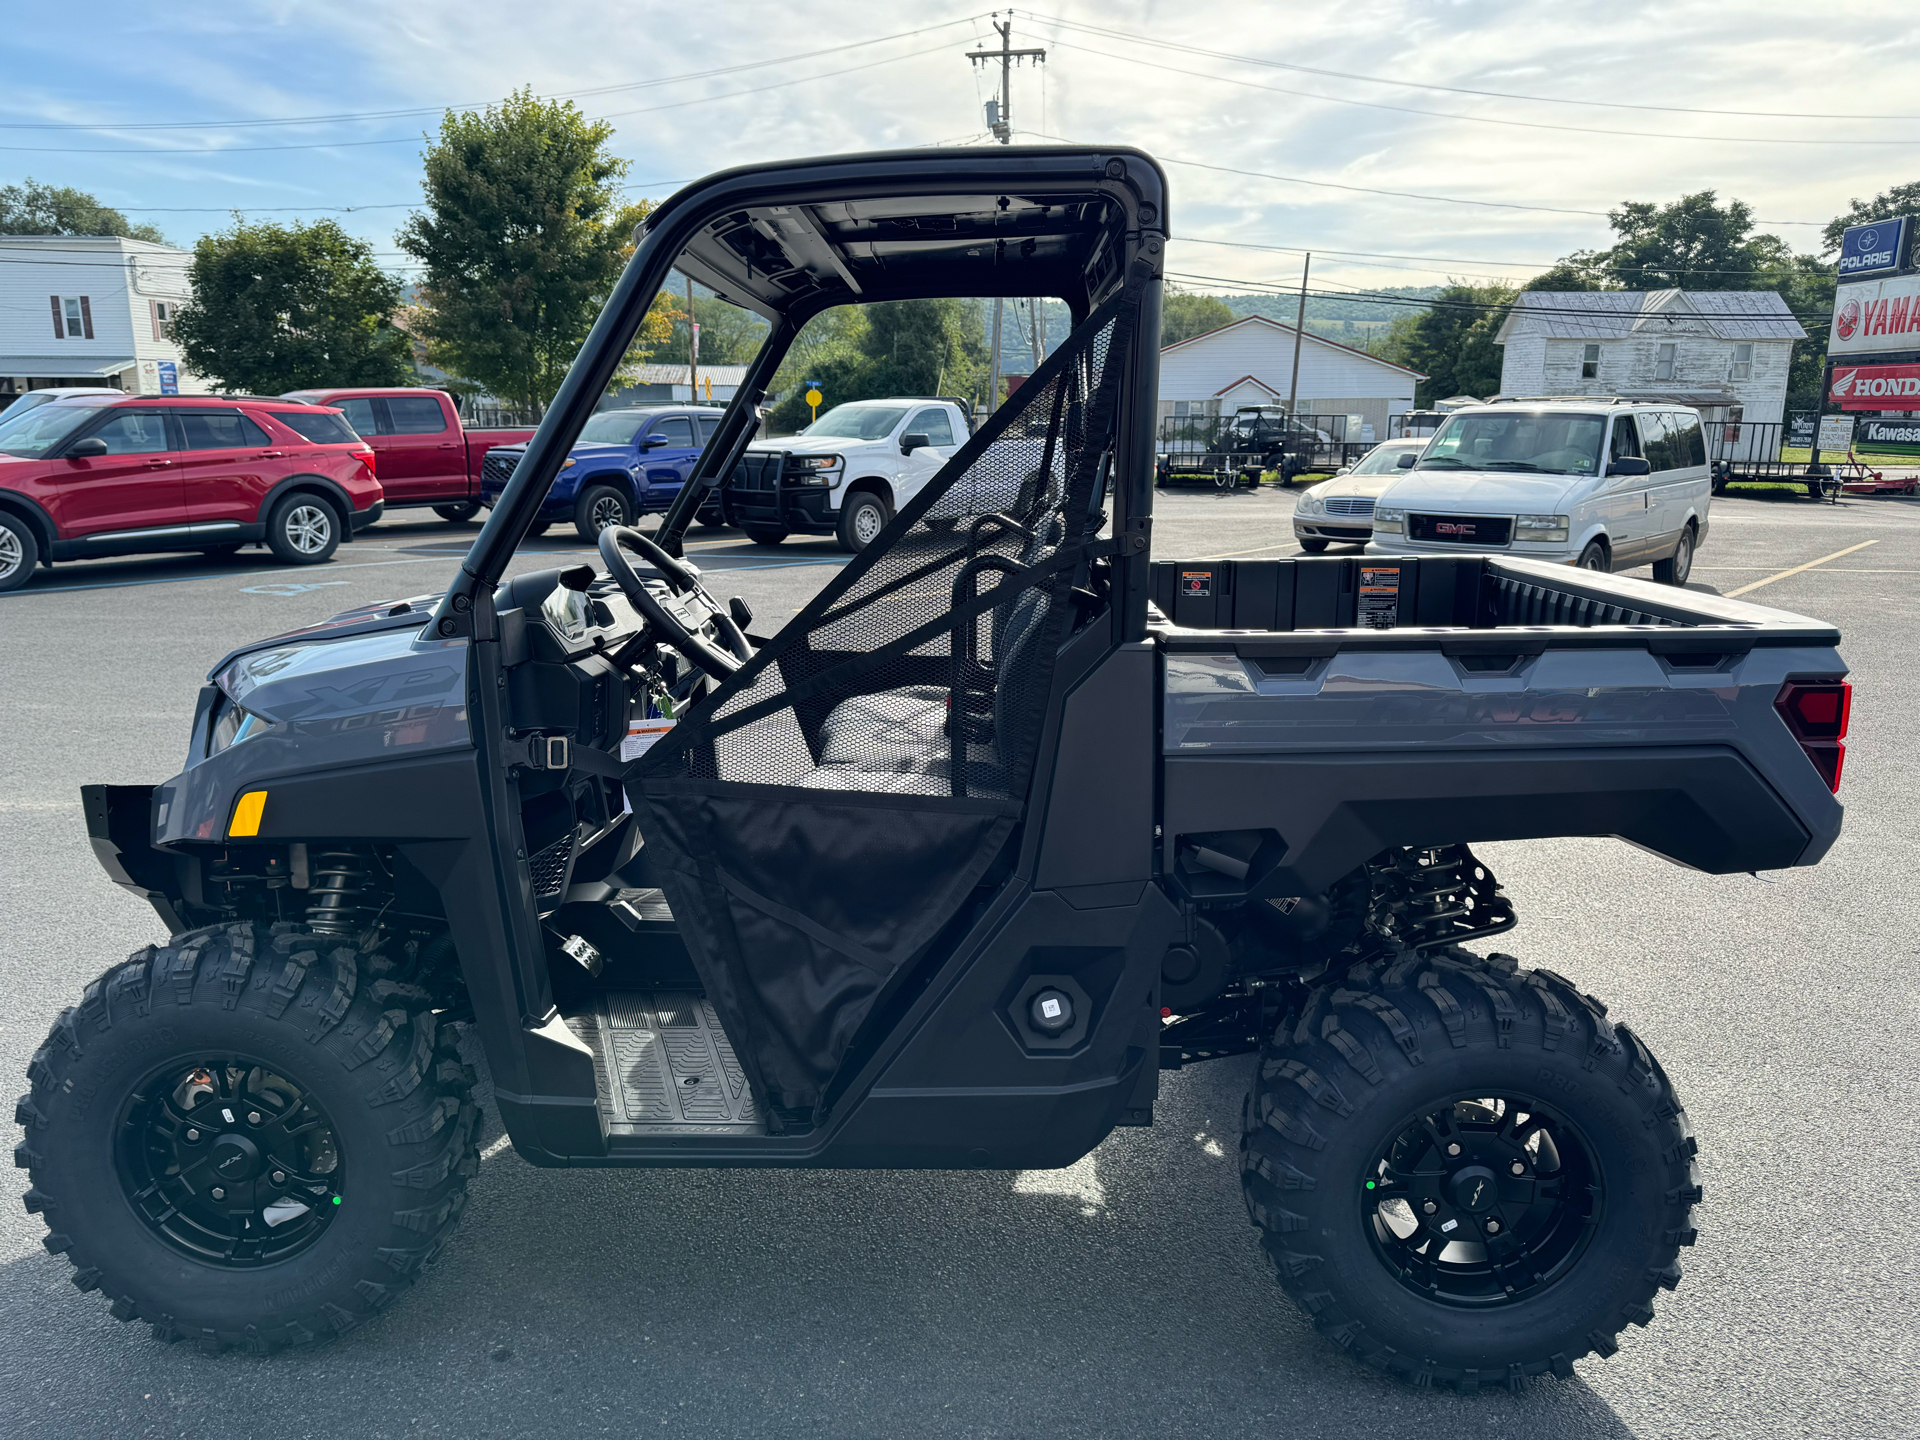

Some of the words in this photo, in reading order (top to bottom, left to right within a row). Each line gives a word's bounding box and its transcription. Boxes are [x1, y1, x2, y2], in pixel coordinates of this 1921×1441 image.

[1839, 250, 1892, 270] POLARIS
[1853, 378, 1921, 397] HOND
[1436, 522, 1476, 535] GMC
[287, 665, 461, 721] XP
[329, 700, 447, 732] 1000
[1358, 692, 1690, 725] RANGER
[218, 1152, 244, 1170] XP
[1471, 1179, 1486, 1207] XP
